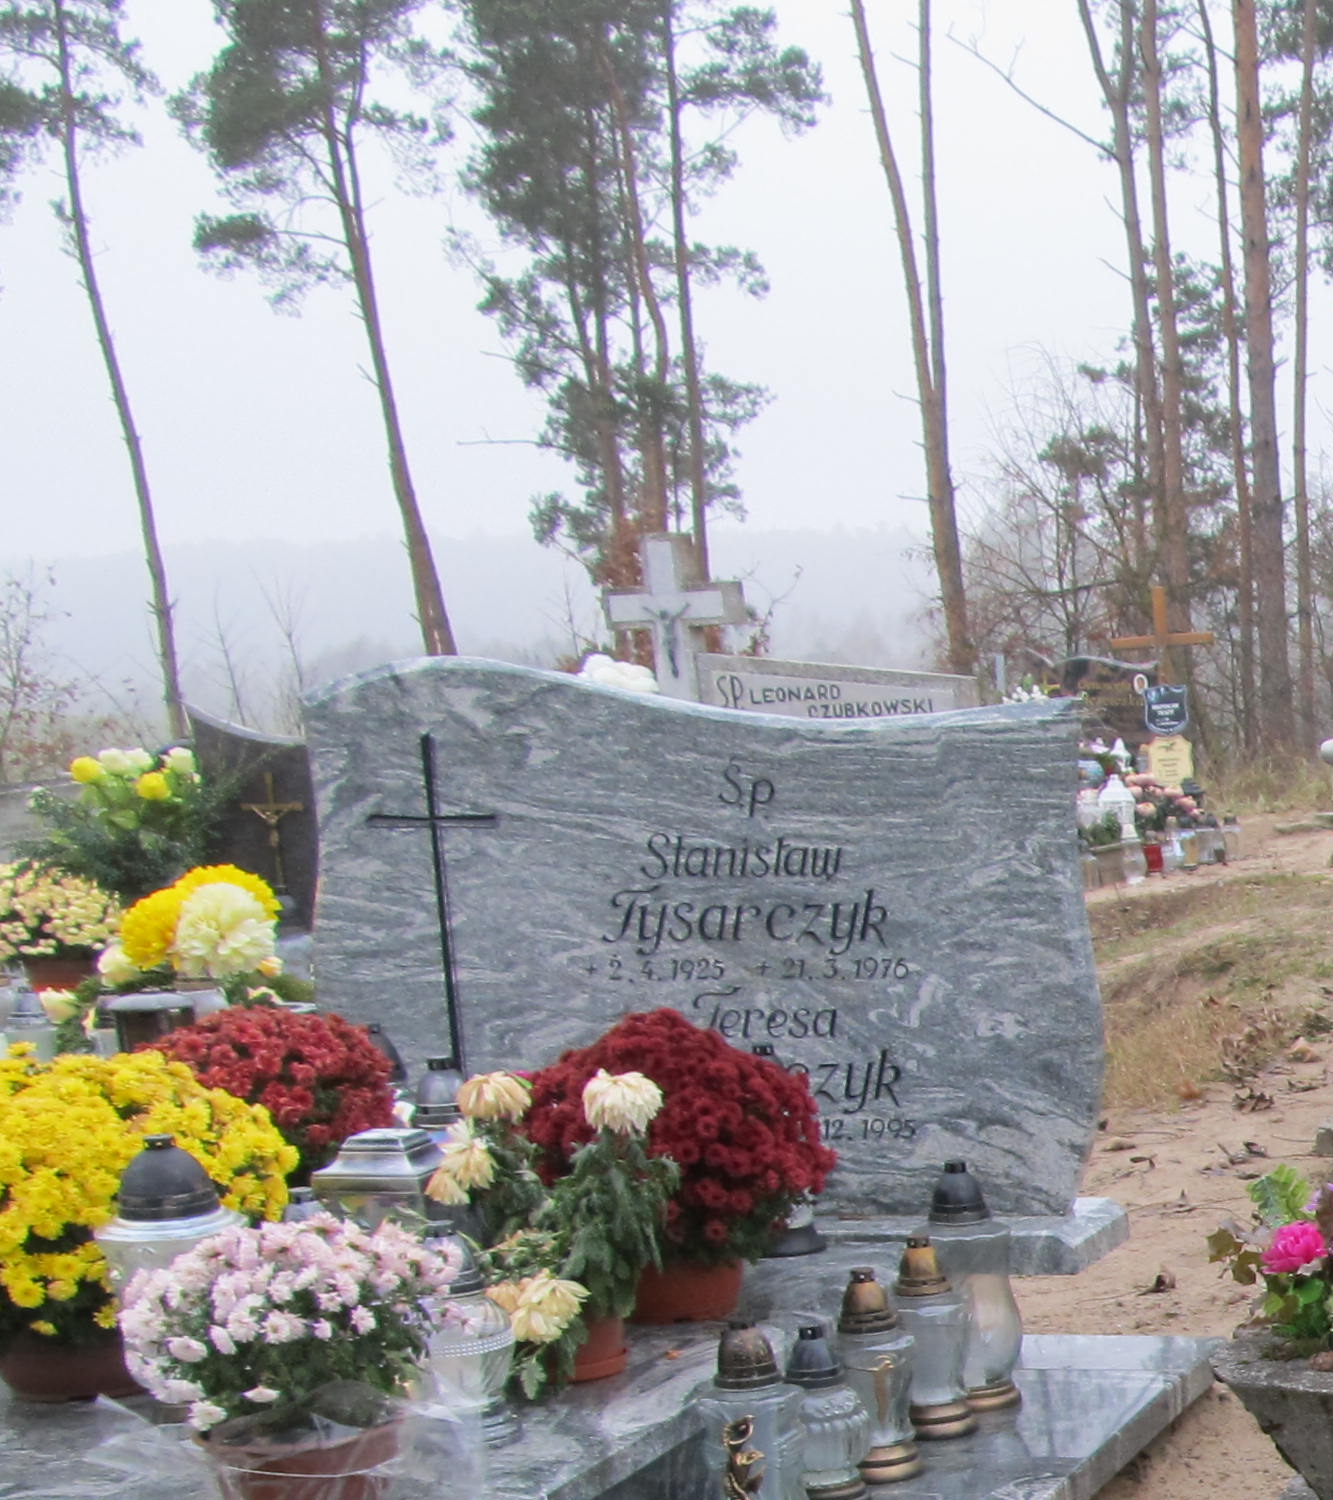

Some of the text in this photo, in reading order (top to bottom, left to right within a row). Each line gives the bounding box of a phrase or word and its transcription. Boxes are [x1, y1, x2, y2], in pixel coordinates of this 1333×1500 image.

[749, 684, 841, 705] LEONARD
[640, 832, 842, 882] Stanisław
[602, 884, 889, 956] Tysarczyk
[693, 986, 837, 1039] Teresa
